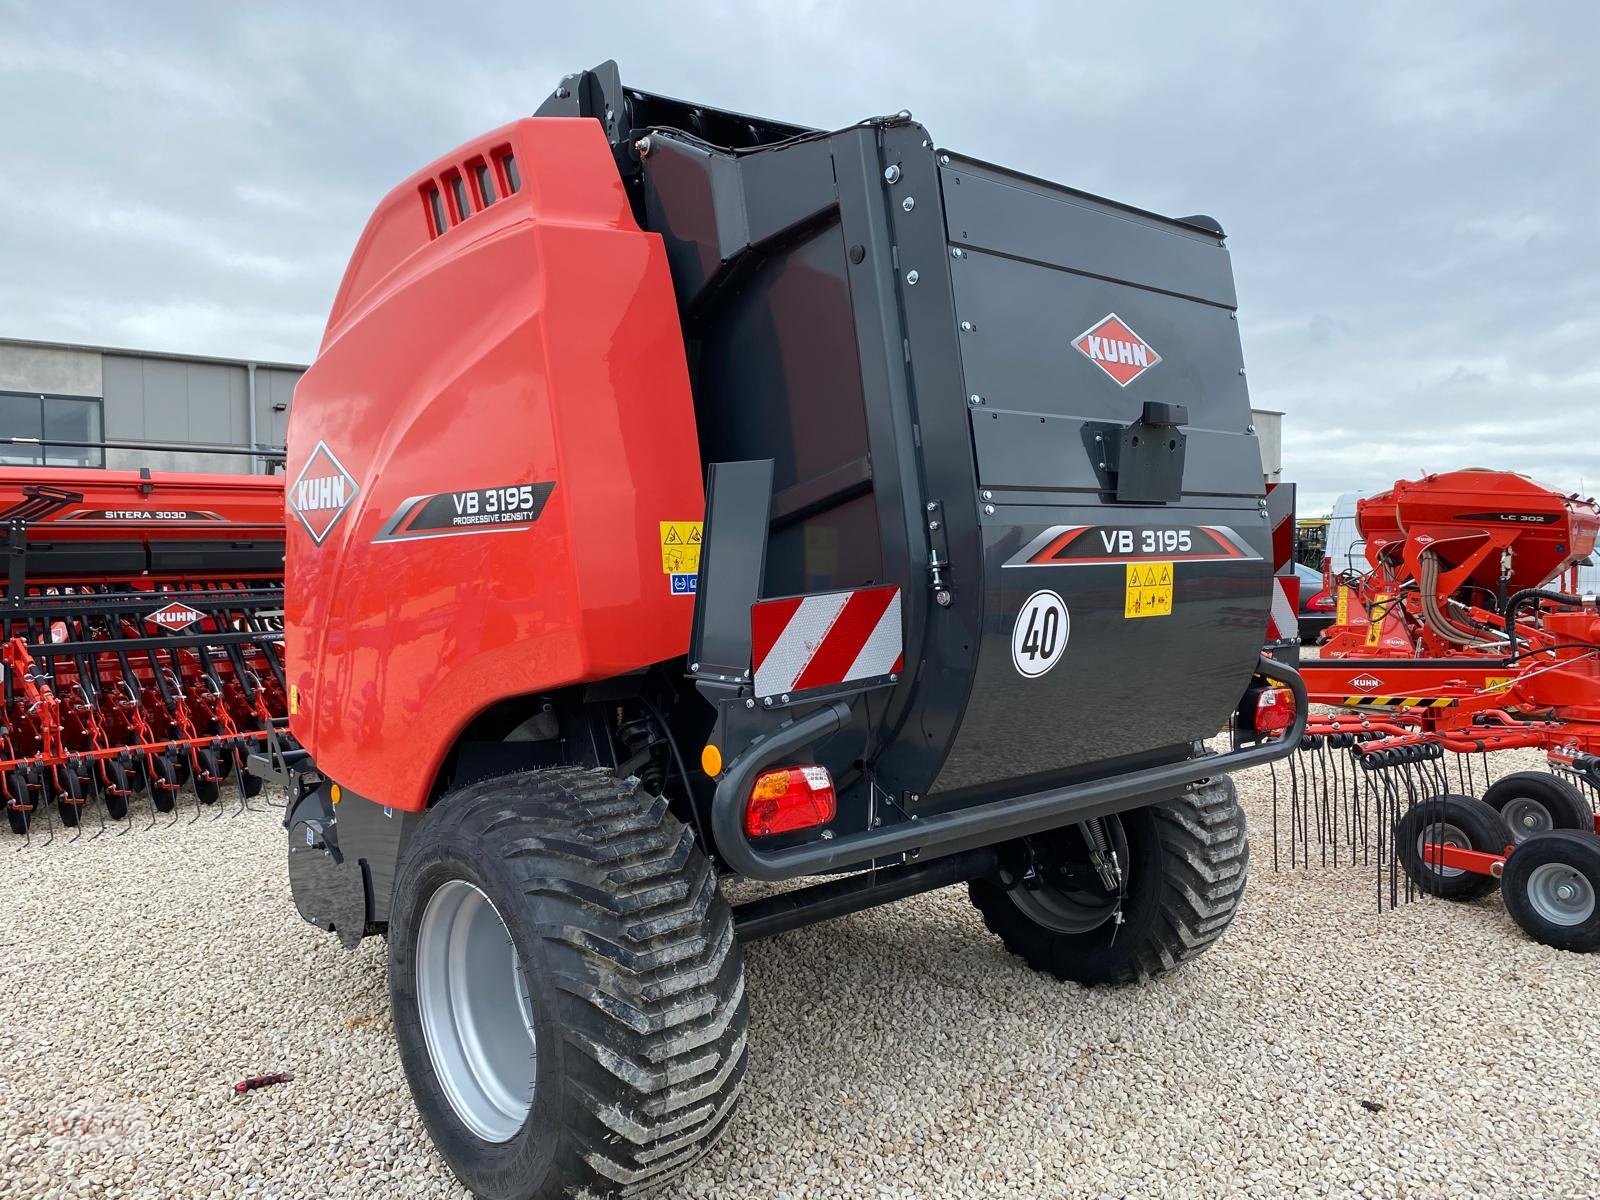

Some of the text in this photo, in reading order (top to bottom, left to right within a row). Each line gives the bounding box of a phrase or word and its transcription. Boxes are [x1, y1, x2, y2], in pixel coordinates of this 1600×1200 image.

[1087, 335, 1148, 367] KUHN
[298, 474, 345, 511] KUHN
[453, 486, 534, 514] VB 3195
[105, 511, 187, 520] SITERA 3030
[453, 511, 534, 525] PROGRESSIVE DENSITY
[1100, 530, 1192, 553] VB 3195
[156, 611, 197, 622] KUHN
[1021, 605, 1059, 660] 40
[1353, 679, 1379, 687] KUHN
